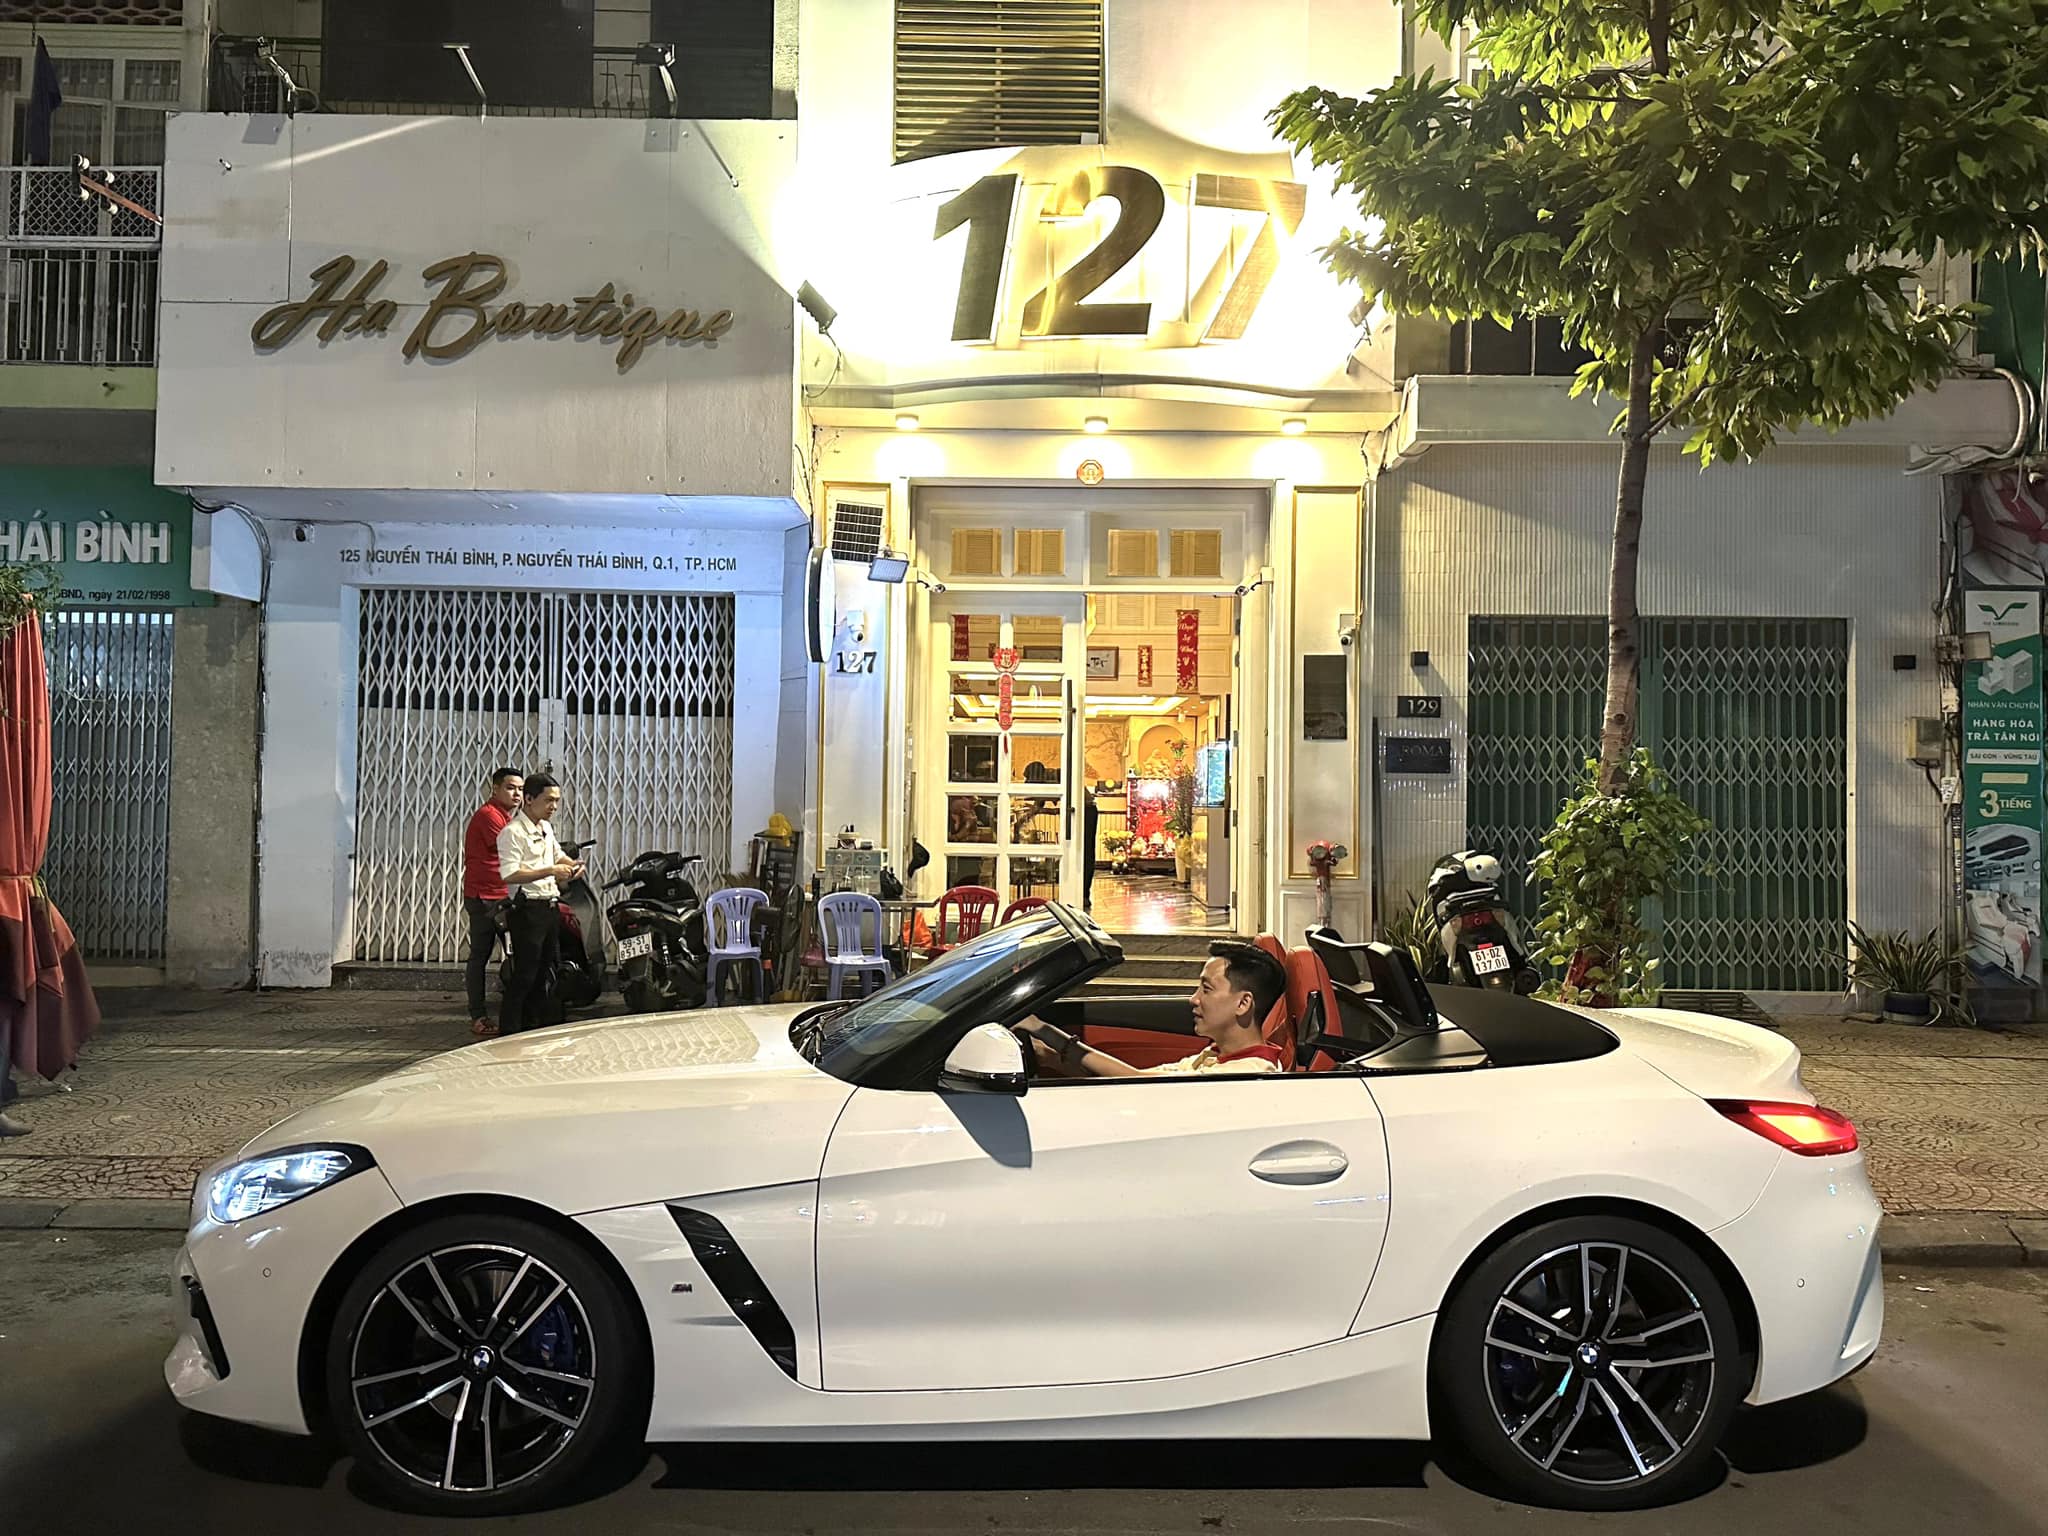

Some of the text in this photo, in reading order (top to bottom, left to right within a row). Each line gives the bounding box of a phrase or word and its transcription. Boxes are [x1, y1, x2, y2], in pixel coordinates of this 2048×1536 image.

[933, 166, 1306, 341] 127
[251, 250, 735, 369] Ha Boutique
[76, 510, 171, 563] BÌNH
[339, 544, 737, 573] 125 NGUYỄN THÁI BÌNH, P. NGUYỄN THÁI BÌNH, Q.1, TP. HCM
[116, 589, 170, 600] 21/02/1998
[836, 651, 877, 674] 127
[1408, 699, 1438, 714] 129
[1979, 789, 2032, 818] 3 TIẾNG
